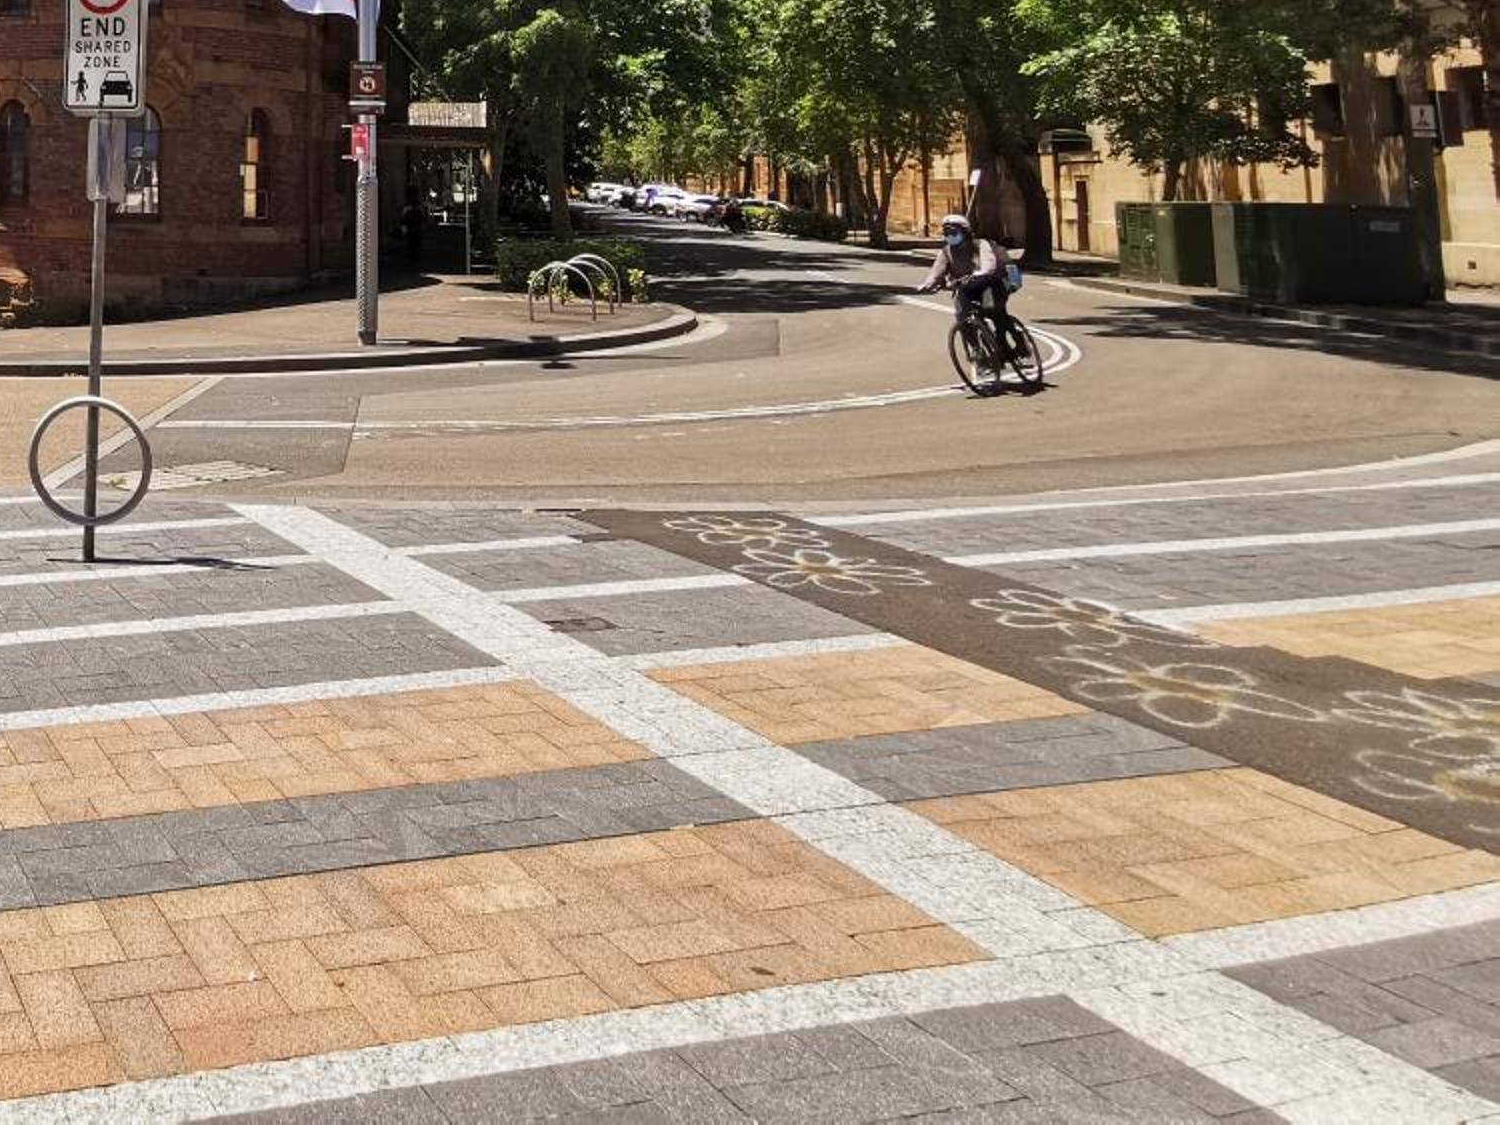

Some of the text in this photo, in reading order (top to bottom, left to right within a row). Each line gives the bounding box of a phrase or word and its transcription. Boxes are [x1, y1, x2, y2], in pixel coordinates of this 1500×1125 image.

[80, 17, 126, 37] END
[75, 40, 131, 54] SHARED
[83, 55, 121, 68] ZONE
